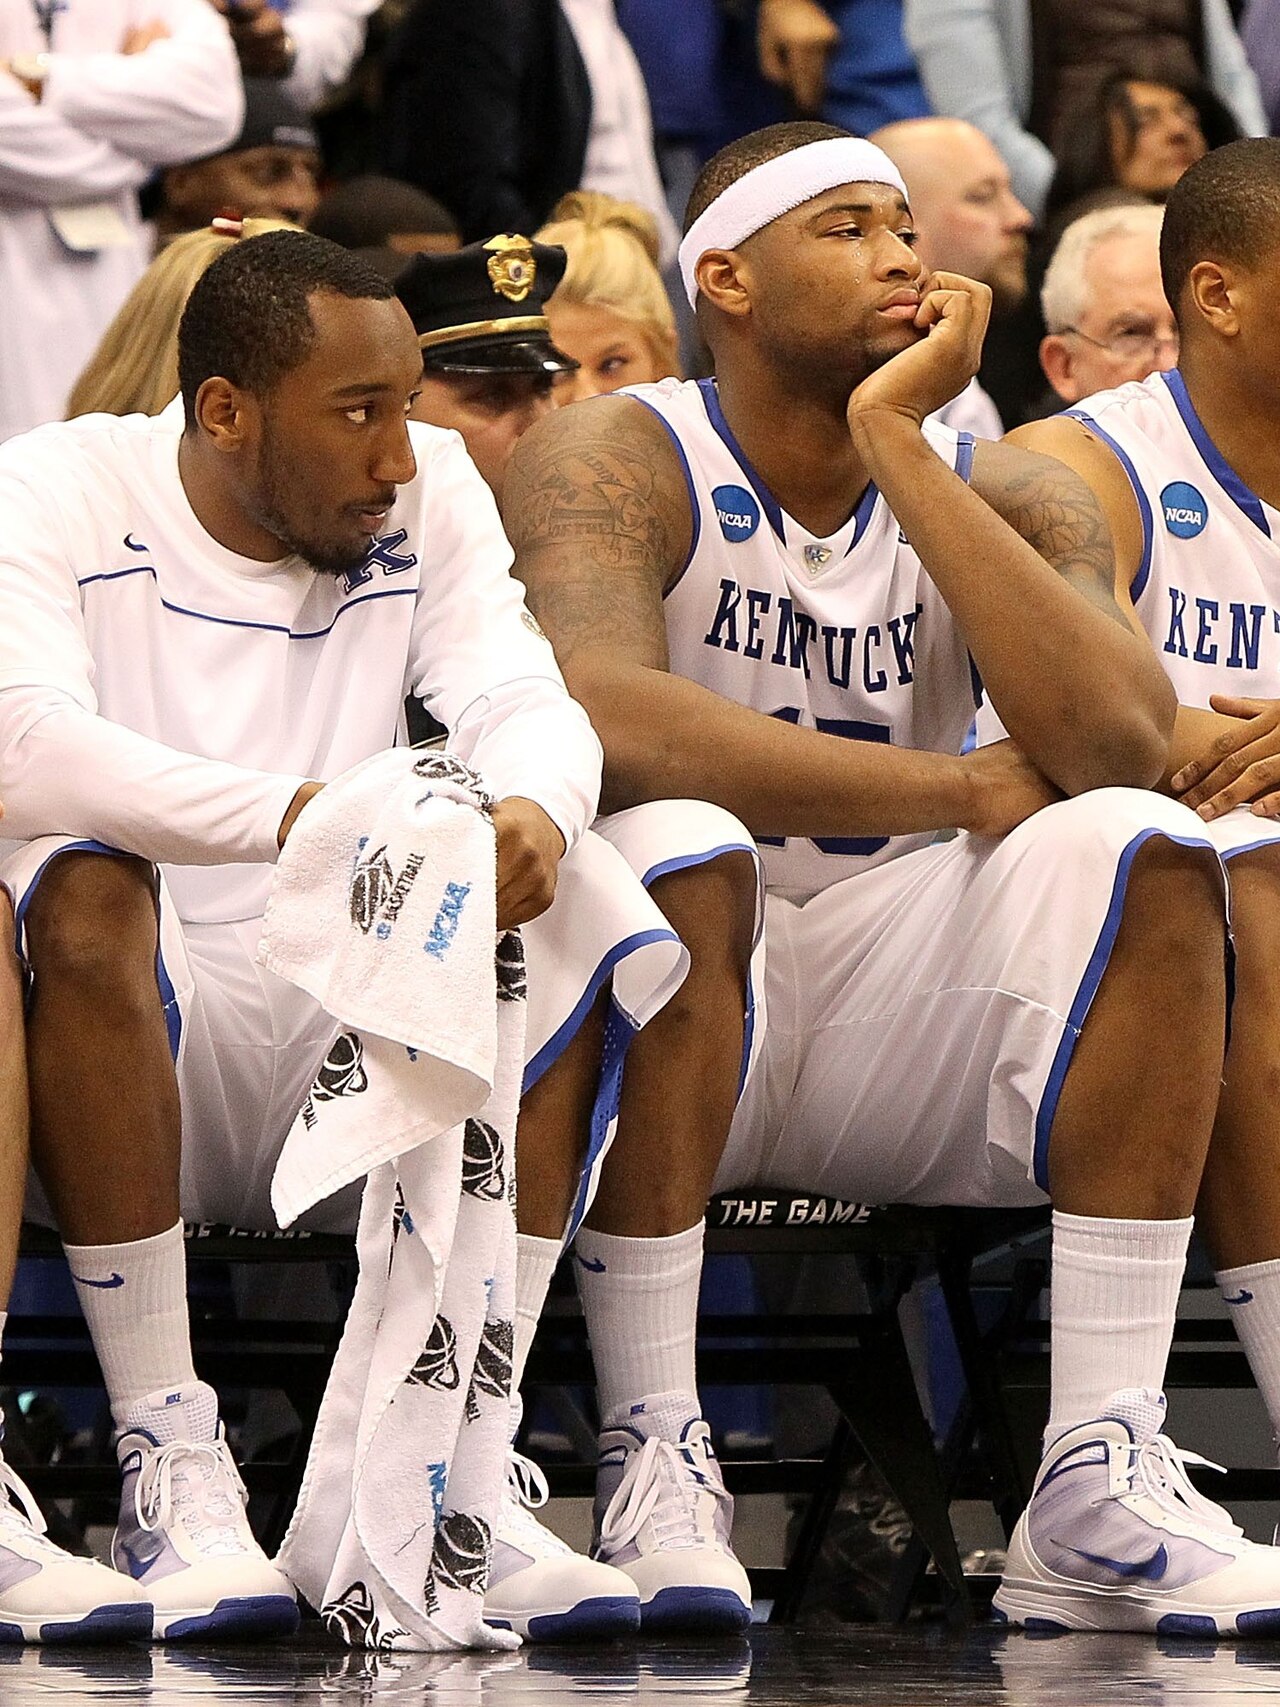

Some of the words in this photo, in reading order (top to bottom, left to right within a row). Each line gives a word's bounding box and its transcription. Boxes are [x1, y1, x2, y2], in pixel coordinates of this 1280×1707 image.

[717, 509, 752, 529] NCAA
[1165, 507, 1202, 526] NCAA
[703, 577, 923, 693] KENTUCK
[382, 852, 426, 923] BASKETBALL
[424, 881, 471, 962] NCAA
[719, 1199, 778, 1226] THE
[785, 1198, 877, 1226] GAME
